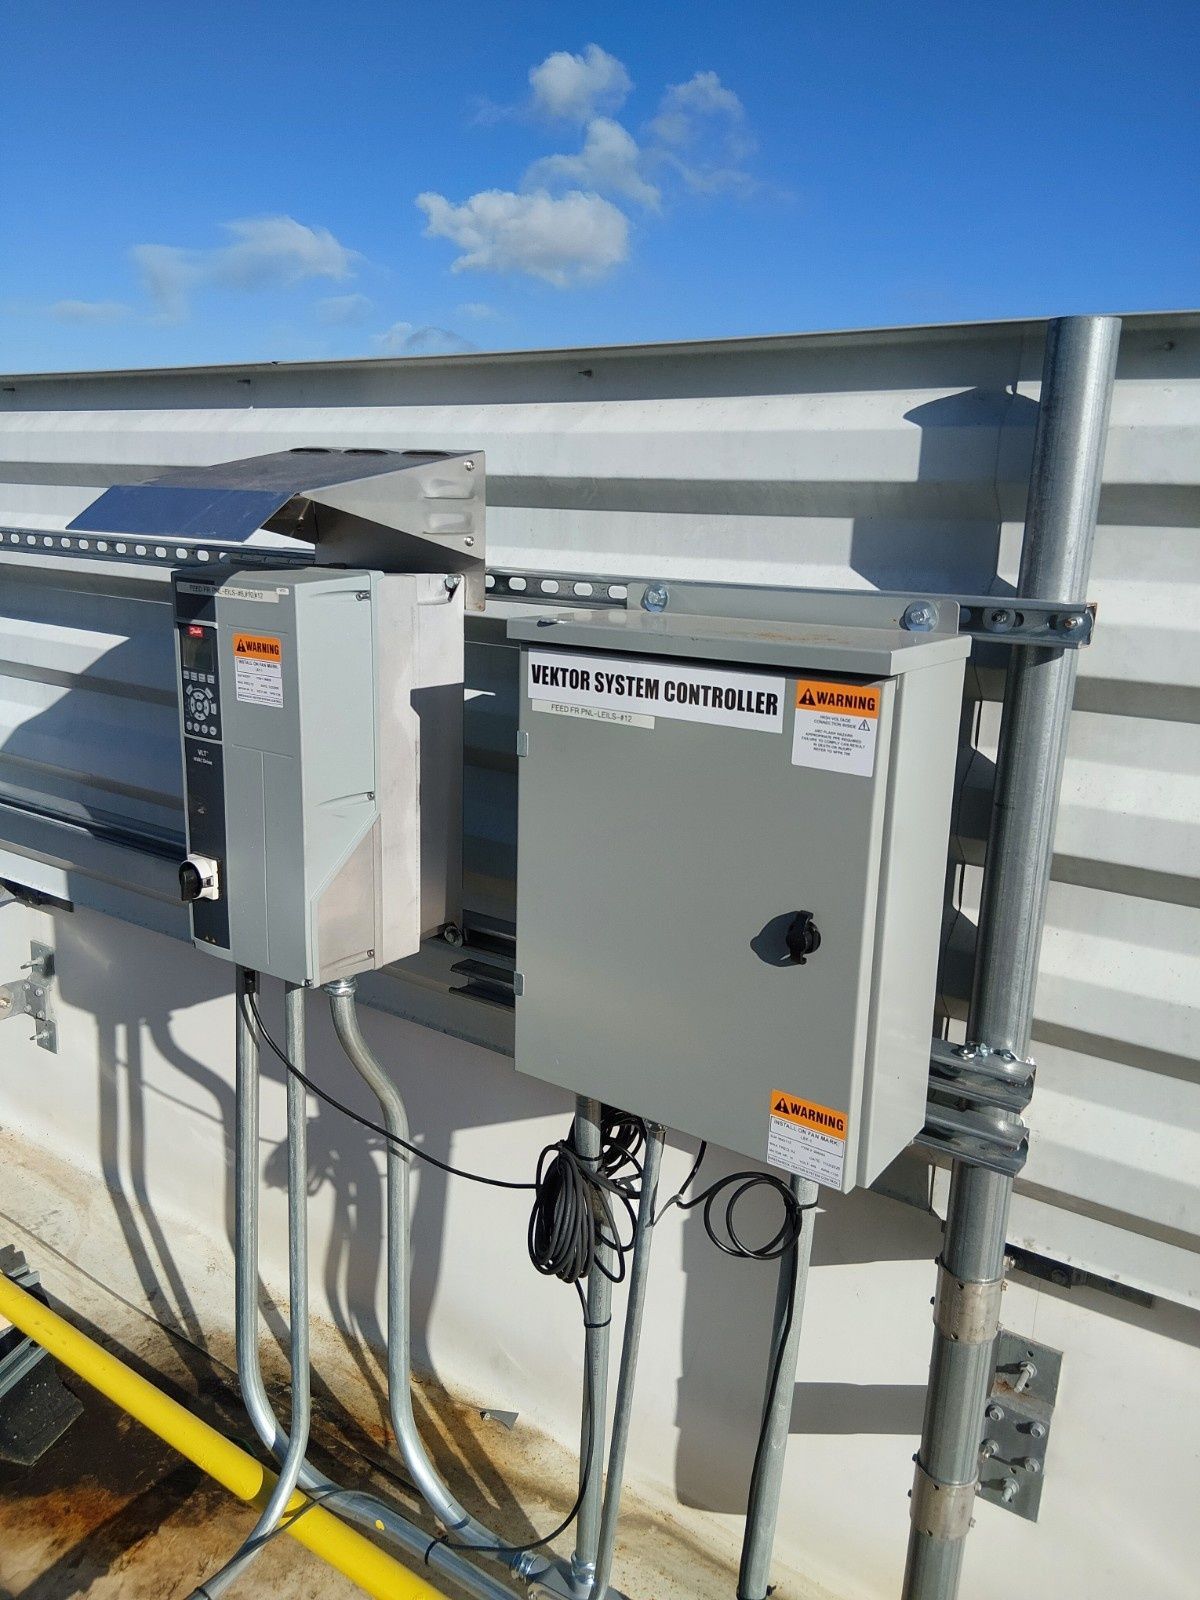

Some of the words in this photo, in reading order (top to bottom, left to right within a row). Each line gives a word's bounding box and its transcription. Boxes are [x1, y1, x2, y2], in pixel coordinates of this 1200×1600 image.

[245, 640, 280, 656] WARNING
[531, 664, 591, 691] VEKTOR
[594, 673, 660, 700] SYSTEM
[664, 680, 779, 716] CONTROLLER
[551, 703, 569, 713] FEED
[570, 706, 580, 715] FR
[816, 691, 875, 711] WARNING
[790, 1102, 844, 1131] WARNING
[773, 1120, 796, 1131] INSTALL
[807, 1131, 819, 1139] FAN
